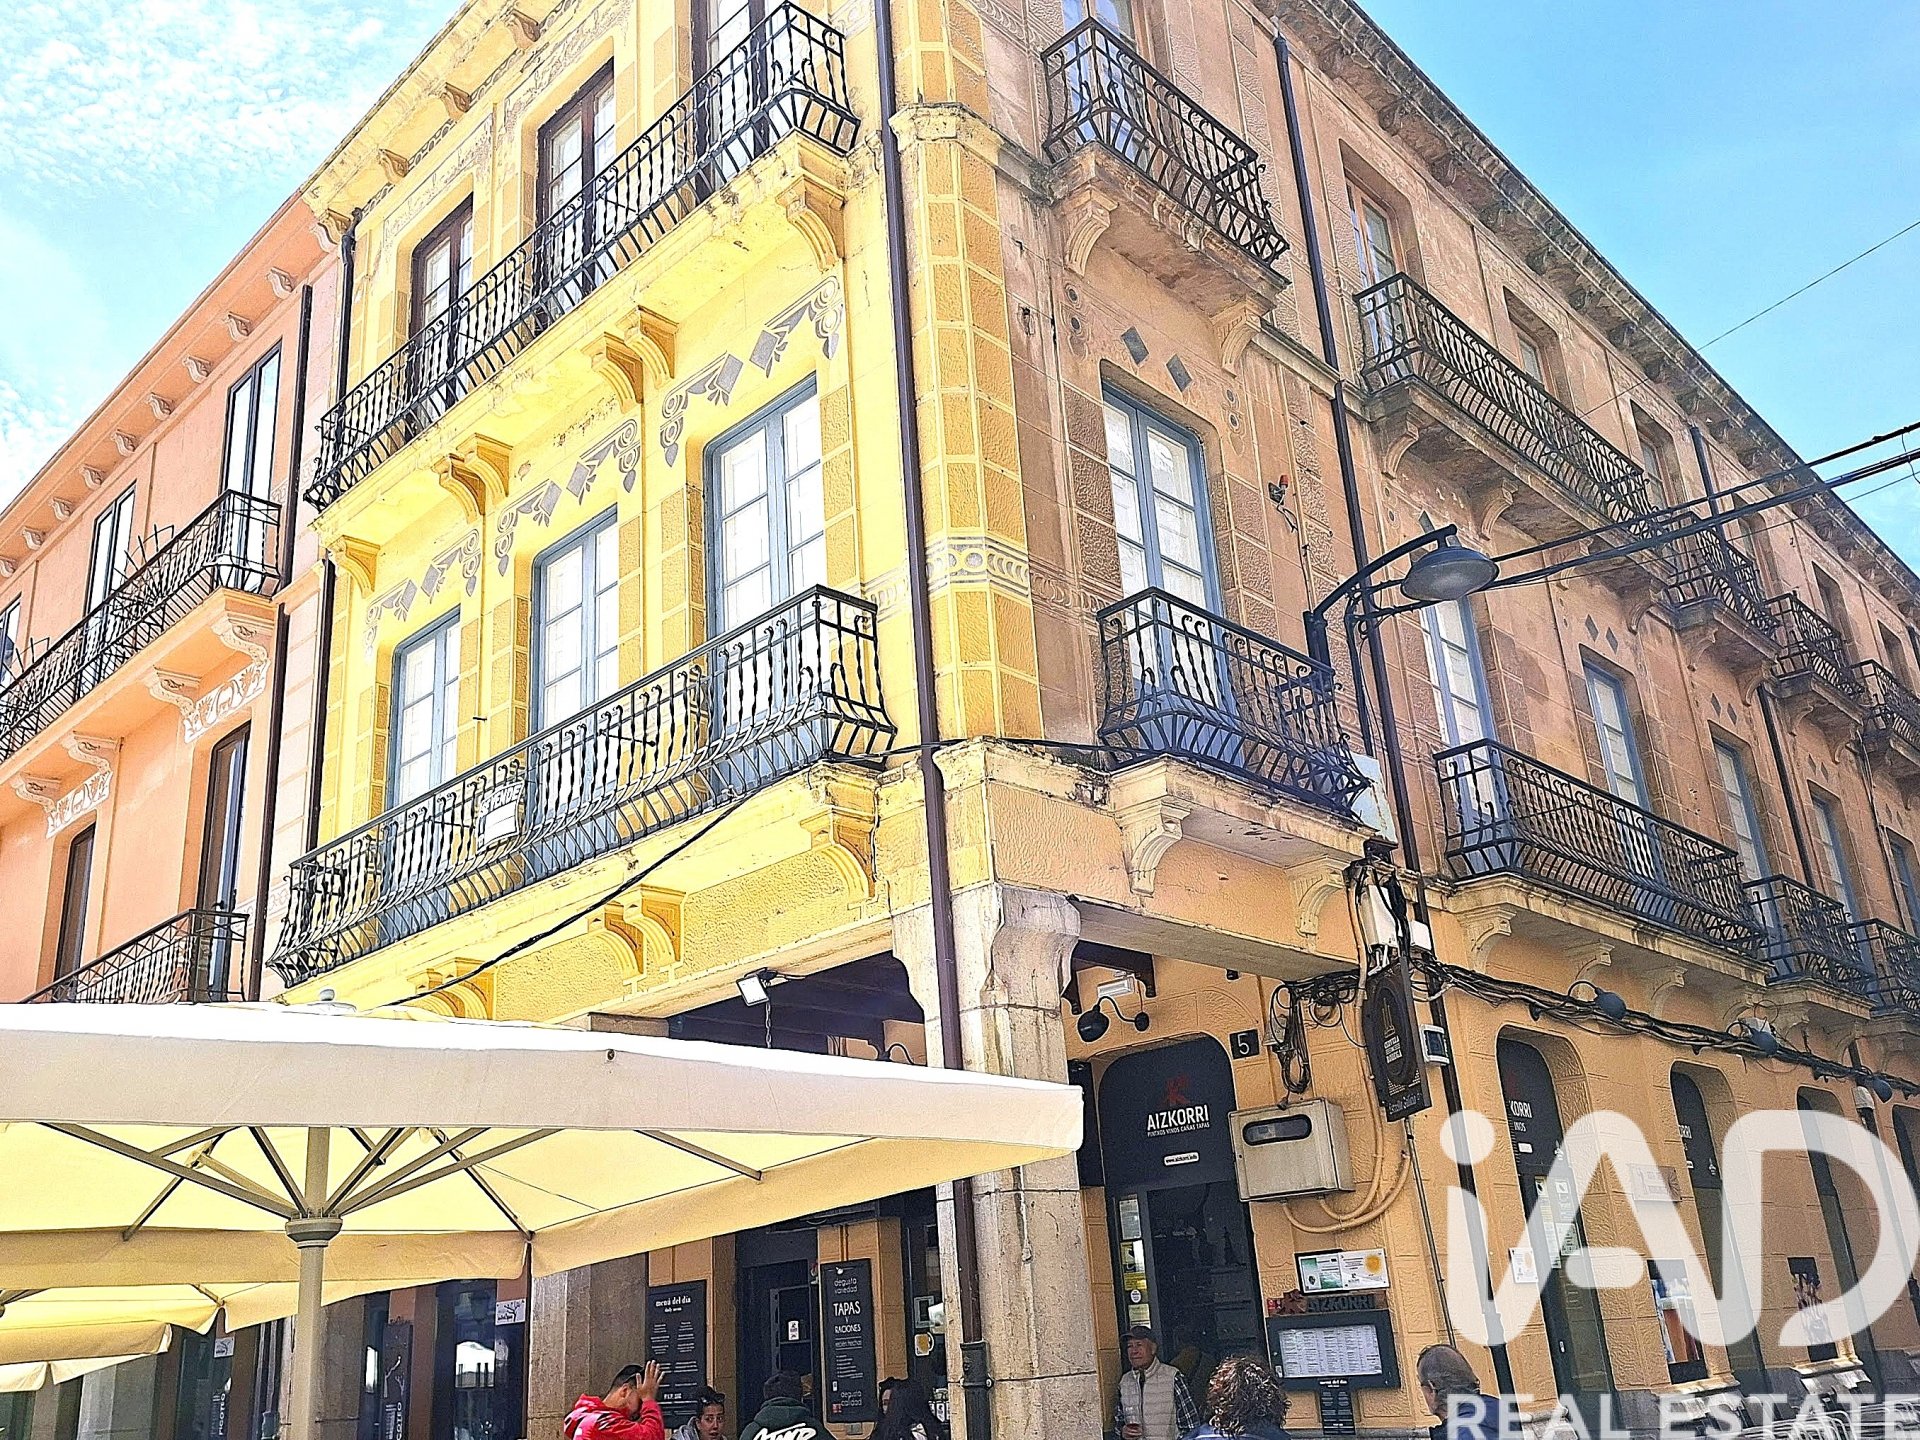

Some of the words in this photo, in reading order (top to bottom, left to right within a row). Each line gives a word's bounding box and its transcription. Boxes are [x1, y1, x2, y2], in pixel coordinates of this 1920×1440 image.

[1237, 1033, 1250, 1055] 5
[1147, 1104, 1209, 1131] AIZKORRI
[1509, 1100, 1532, 1118] KORRI
[1196, 1122, 1210, 1130] TAPAS
[833, 1301, 861, 1317] TAPAS
[834, 1323, 861, 1334] RACIONES
